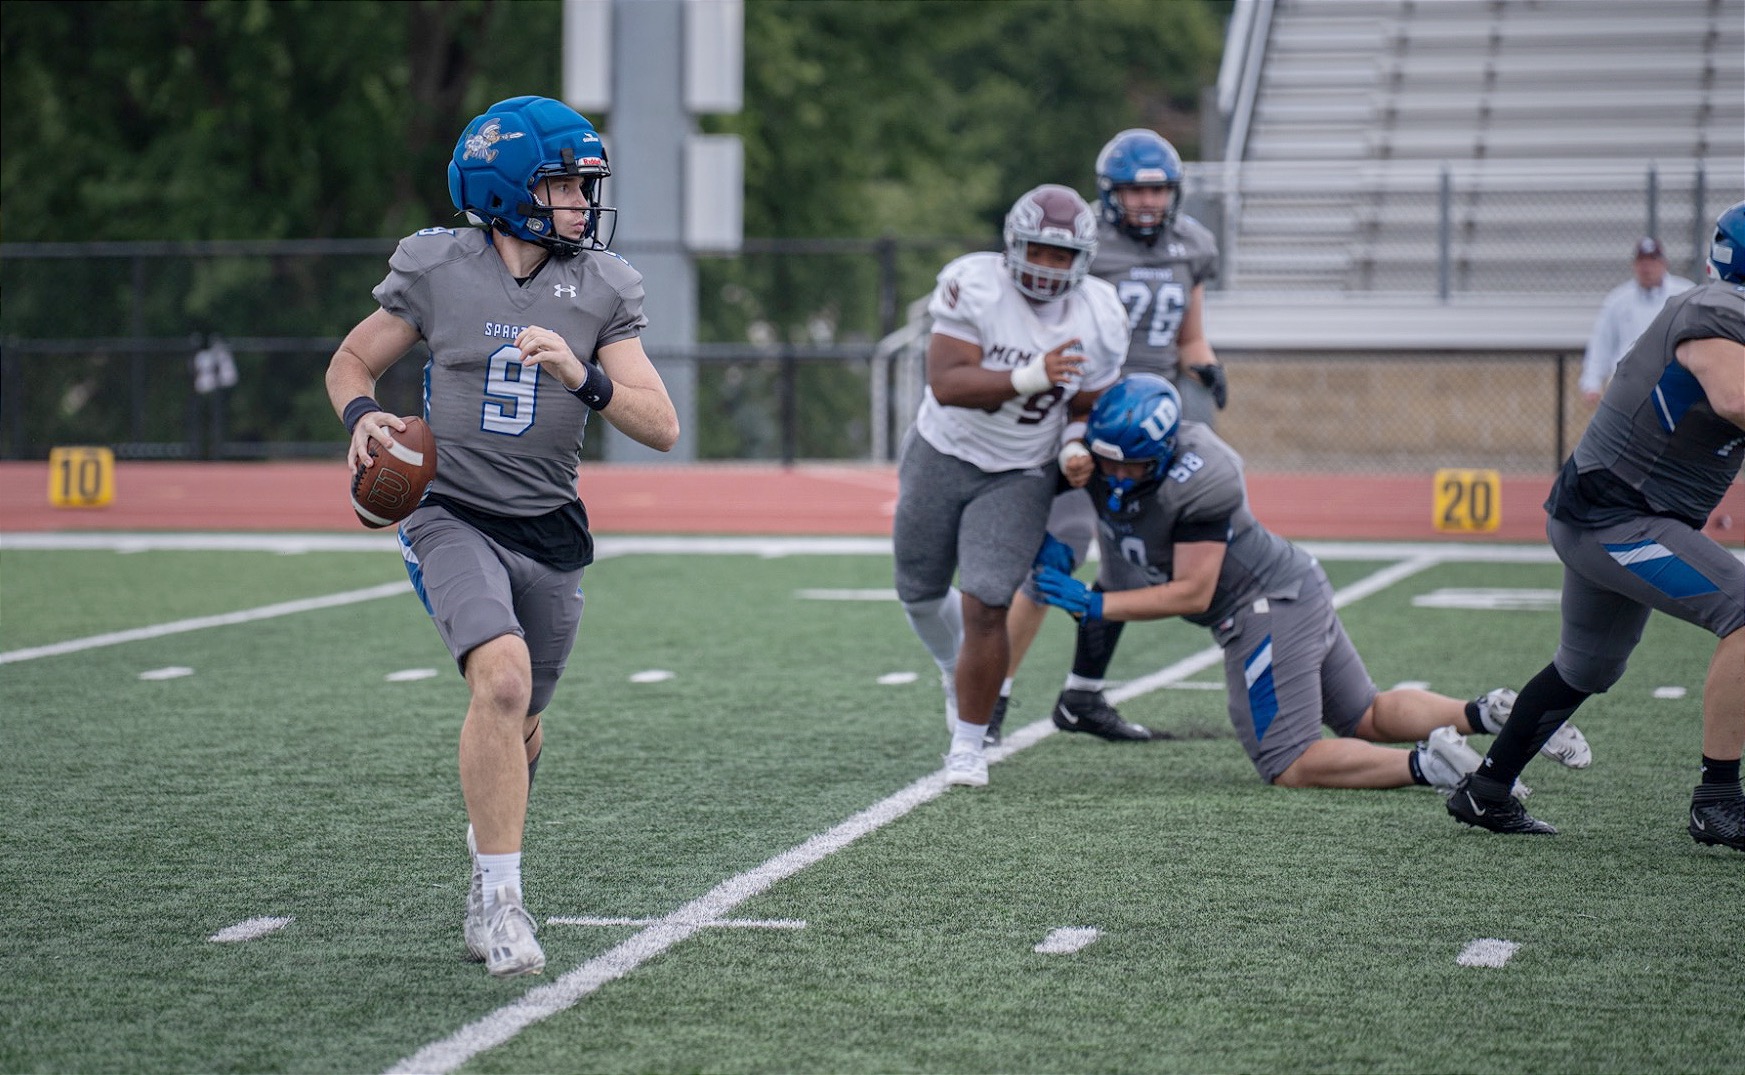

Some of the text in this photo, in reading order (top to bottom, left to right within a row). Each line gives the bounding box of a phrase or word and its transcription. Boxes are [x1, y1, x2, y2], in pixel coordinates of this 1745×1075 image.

[1119, 280, 1184, 347] 76
[480, 343, 541, 437] 9
[62, 456, 102, 501] 10
[1168, 452, 1204, 483] 58
[1442, 479, 1491, 524] 20
